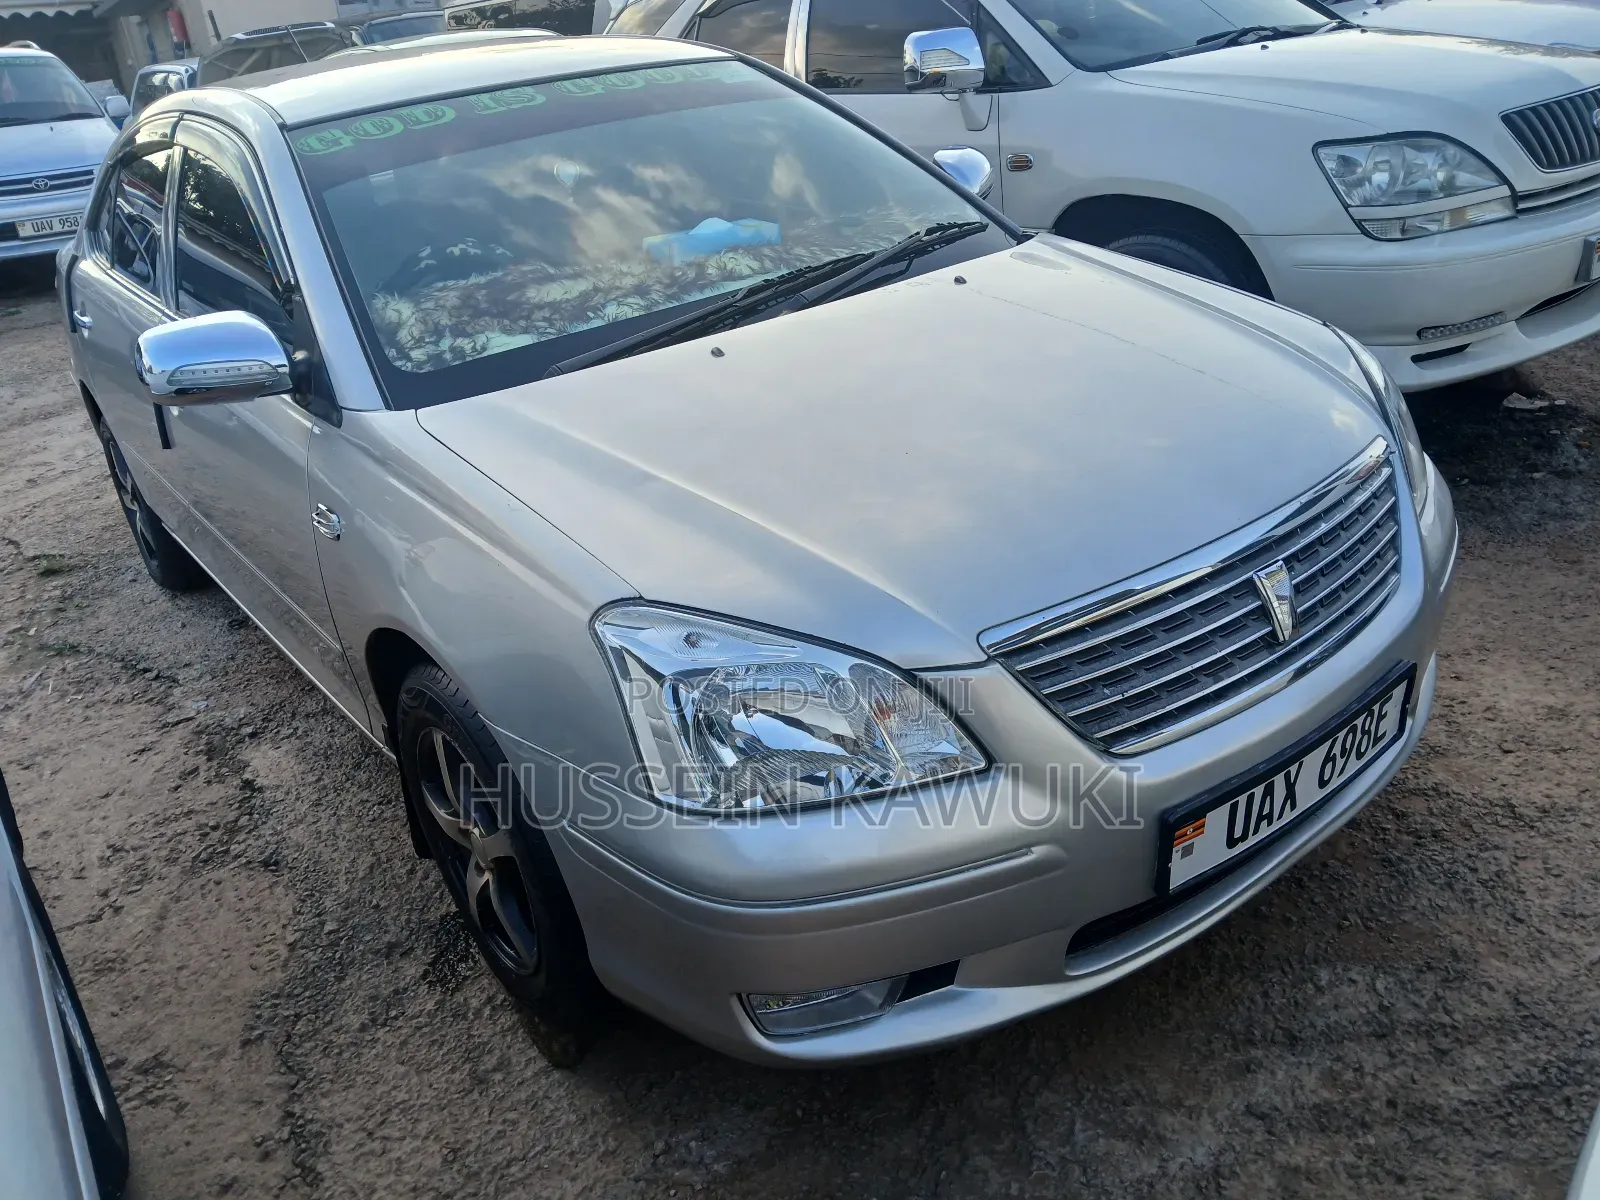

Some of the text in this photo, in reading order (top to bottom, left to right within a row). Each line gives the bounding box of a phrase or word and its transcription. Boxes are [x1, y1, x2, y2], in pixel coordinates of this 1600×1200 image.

[293, 104, 456, 155] GOD
[468, 86, 547, 115] IS
[31, 216, 82, 233] UAV 958
[1225, 692, 1394, 850] UAX 698E
